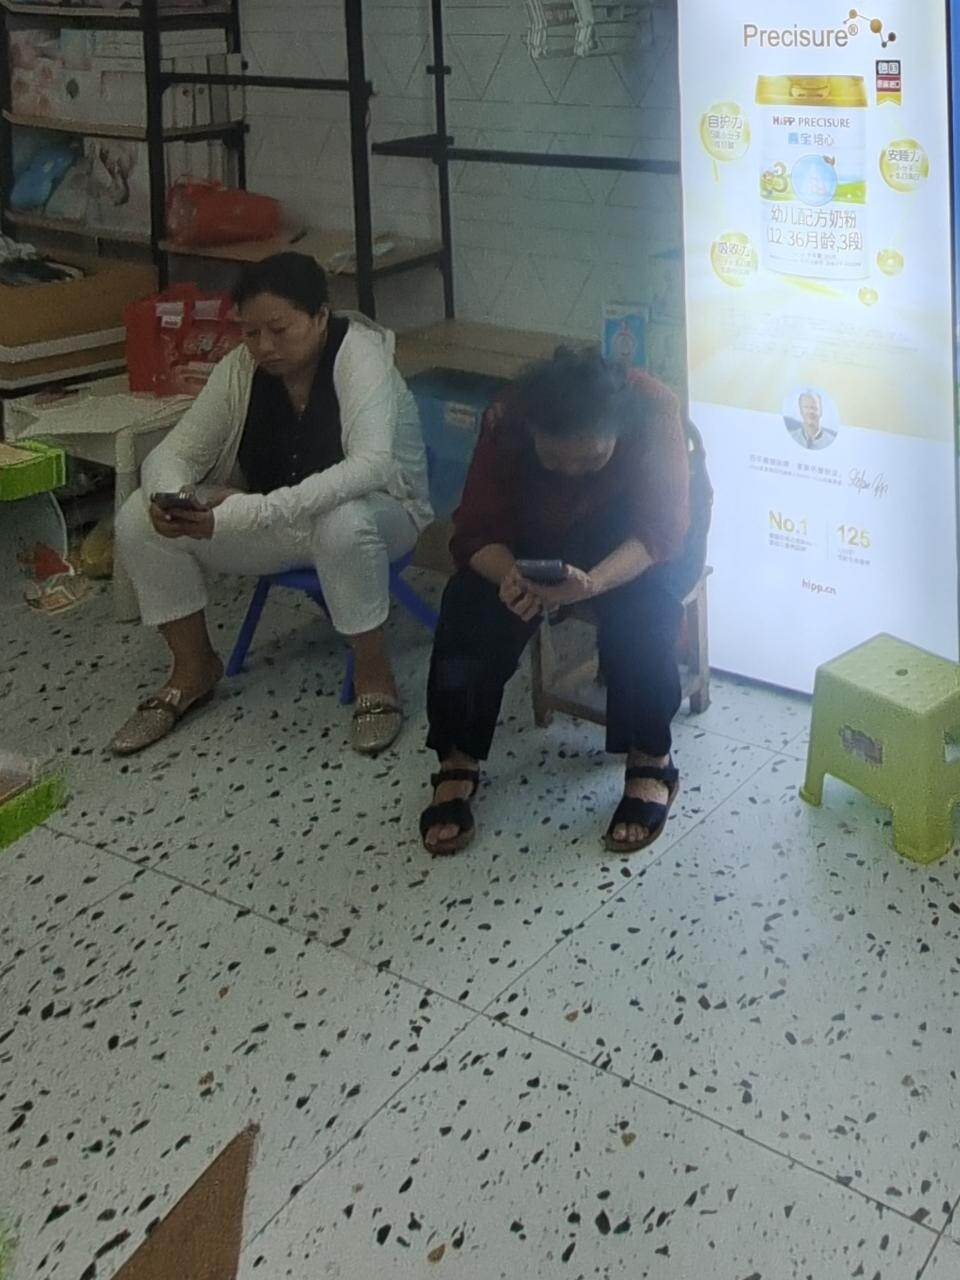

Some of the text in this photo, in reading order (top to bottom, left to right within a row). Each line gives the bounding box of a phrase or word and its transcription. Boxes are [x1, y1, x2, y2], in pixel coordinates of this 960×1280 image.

[798, 117, 851, 128] PRECISURE
[771, 206, 857, 228] 幼儿配方奶粉
[768, 510, 808, 536] No.1
[837, 524, 872, 549] 125
[802, 578, 837, 595] hipp.cn
